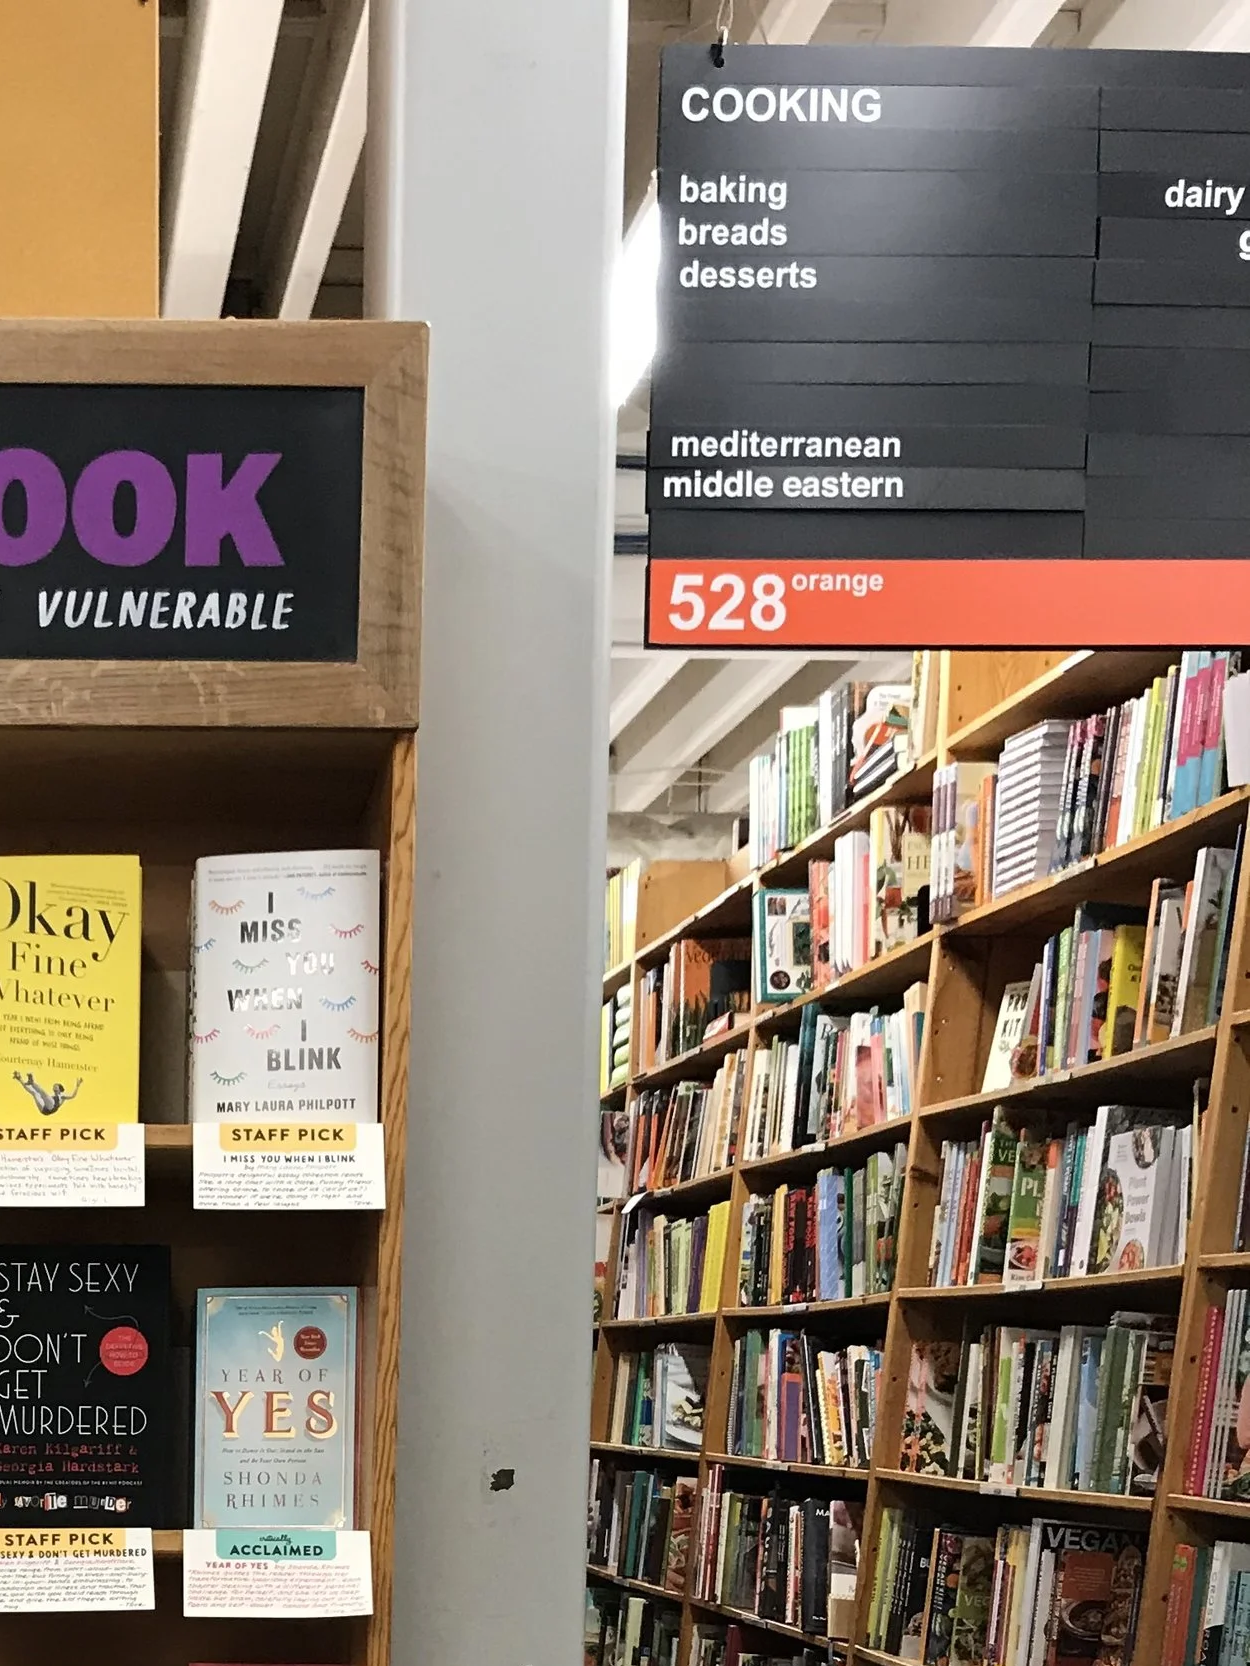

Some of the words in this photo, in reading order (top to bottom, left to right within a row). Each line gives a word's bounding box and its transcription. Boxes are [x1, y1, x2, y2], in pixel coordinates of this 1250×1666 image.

[681, 86, 882, 122] COOKING
[680, 175, 788, 210] baking
[1165, 180, 1244, 215] dairy
[677, 218, 787, 246] breads
[680, 260, 817, 289] desserts
[671, 431, 901, 458] mediterranean
[663, 470, 773, 499] middle
[783, 473, 903, 499] eastern
[37, 590, 294, 631] VULNERABLE
[669, 573, 787, 631] 528
[791, 572, 884, 598] orange
[267, 1047, 342, 1071] BLINK
[216, 1100, 252, 1113] MARY
[255, 1099, 295, 1113] LAURA
[299, 1098, 356, 1111] PHILPOTT
[69, 1263, 139, 1293] SEXY
[221, 1368, 283, 1384] YEAR
[299, 1368, 328, 1383] OF
[210, 1391, 338, 1439] YES
[224, 1471, 323, 1486] SHONDA
[226, 1493, 319, 1509] RHIMES
[230, 1545, 323, 1557] ACCLAIMED
